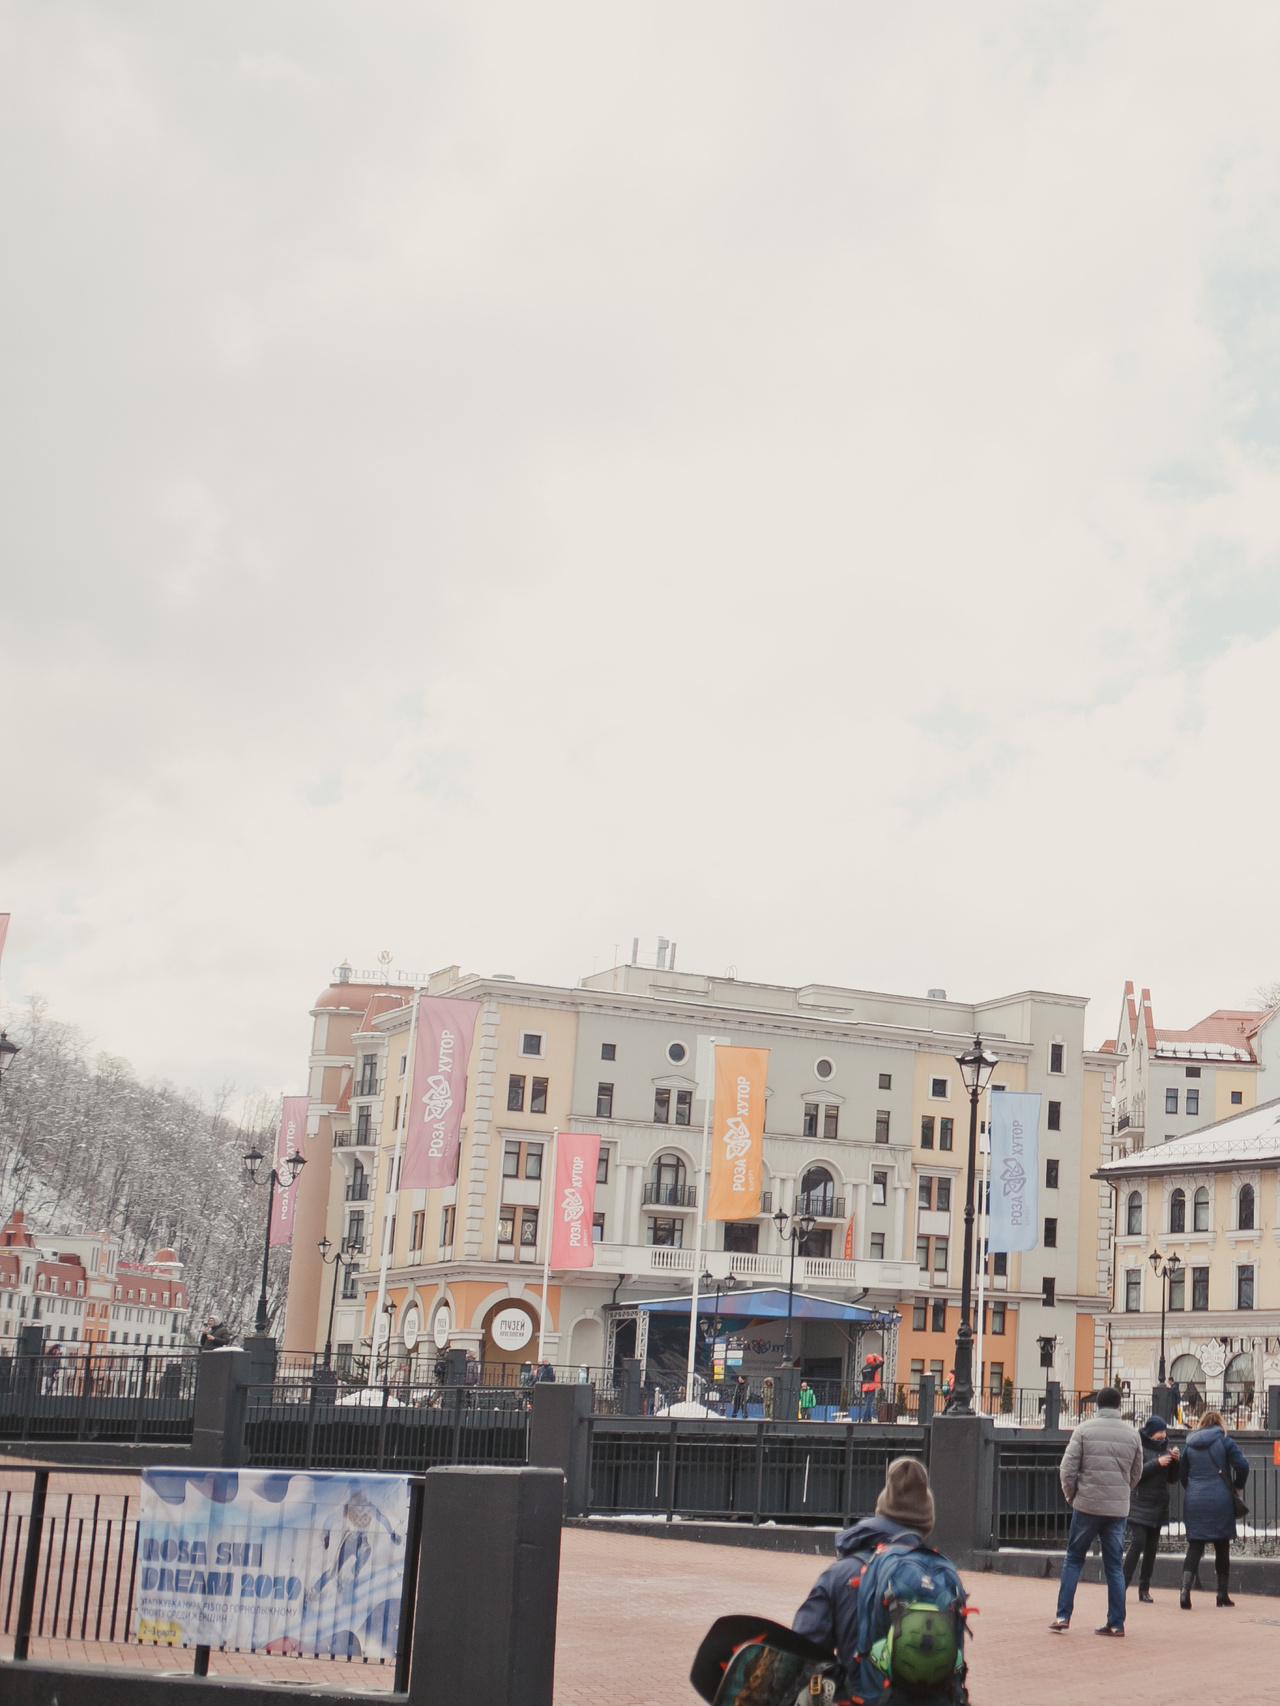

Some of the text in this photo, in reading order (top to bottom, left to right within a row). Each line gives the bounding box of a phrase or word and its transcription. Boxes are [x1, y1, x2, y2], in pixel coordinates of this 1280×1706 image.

[428, 1029, 455, 1157] РОЗА ХУТОР
[286, 1120, 296, 1154] ХУТОР
[732, 1076, 750, 1191] РОЗА ХУТОР
[1011, 1120, 1024, 1226] РОЗА ХУТОР
[570, 1156, 584, 1247] РОЗА ХУТОР
[500, 1319, 525, 1331] МУЗЕЙ
[143, 1538, 263, 1567] ROSA SKI
[141, 1567, 302, 1601] DREAM 2019
[167, 1610, 190, 1620] СРЕДИ
[202, 1602, 215, 1612] FIS
[216, 1603, 229, 1613] ПО
[230, 1604, 298, 1617] ГОРНОЛЫЖНОМУ
